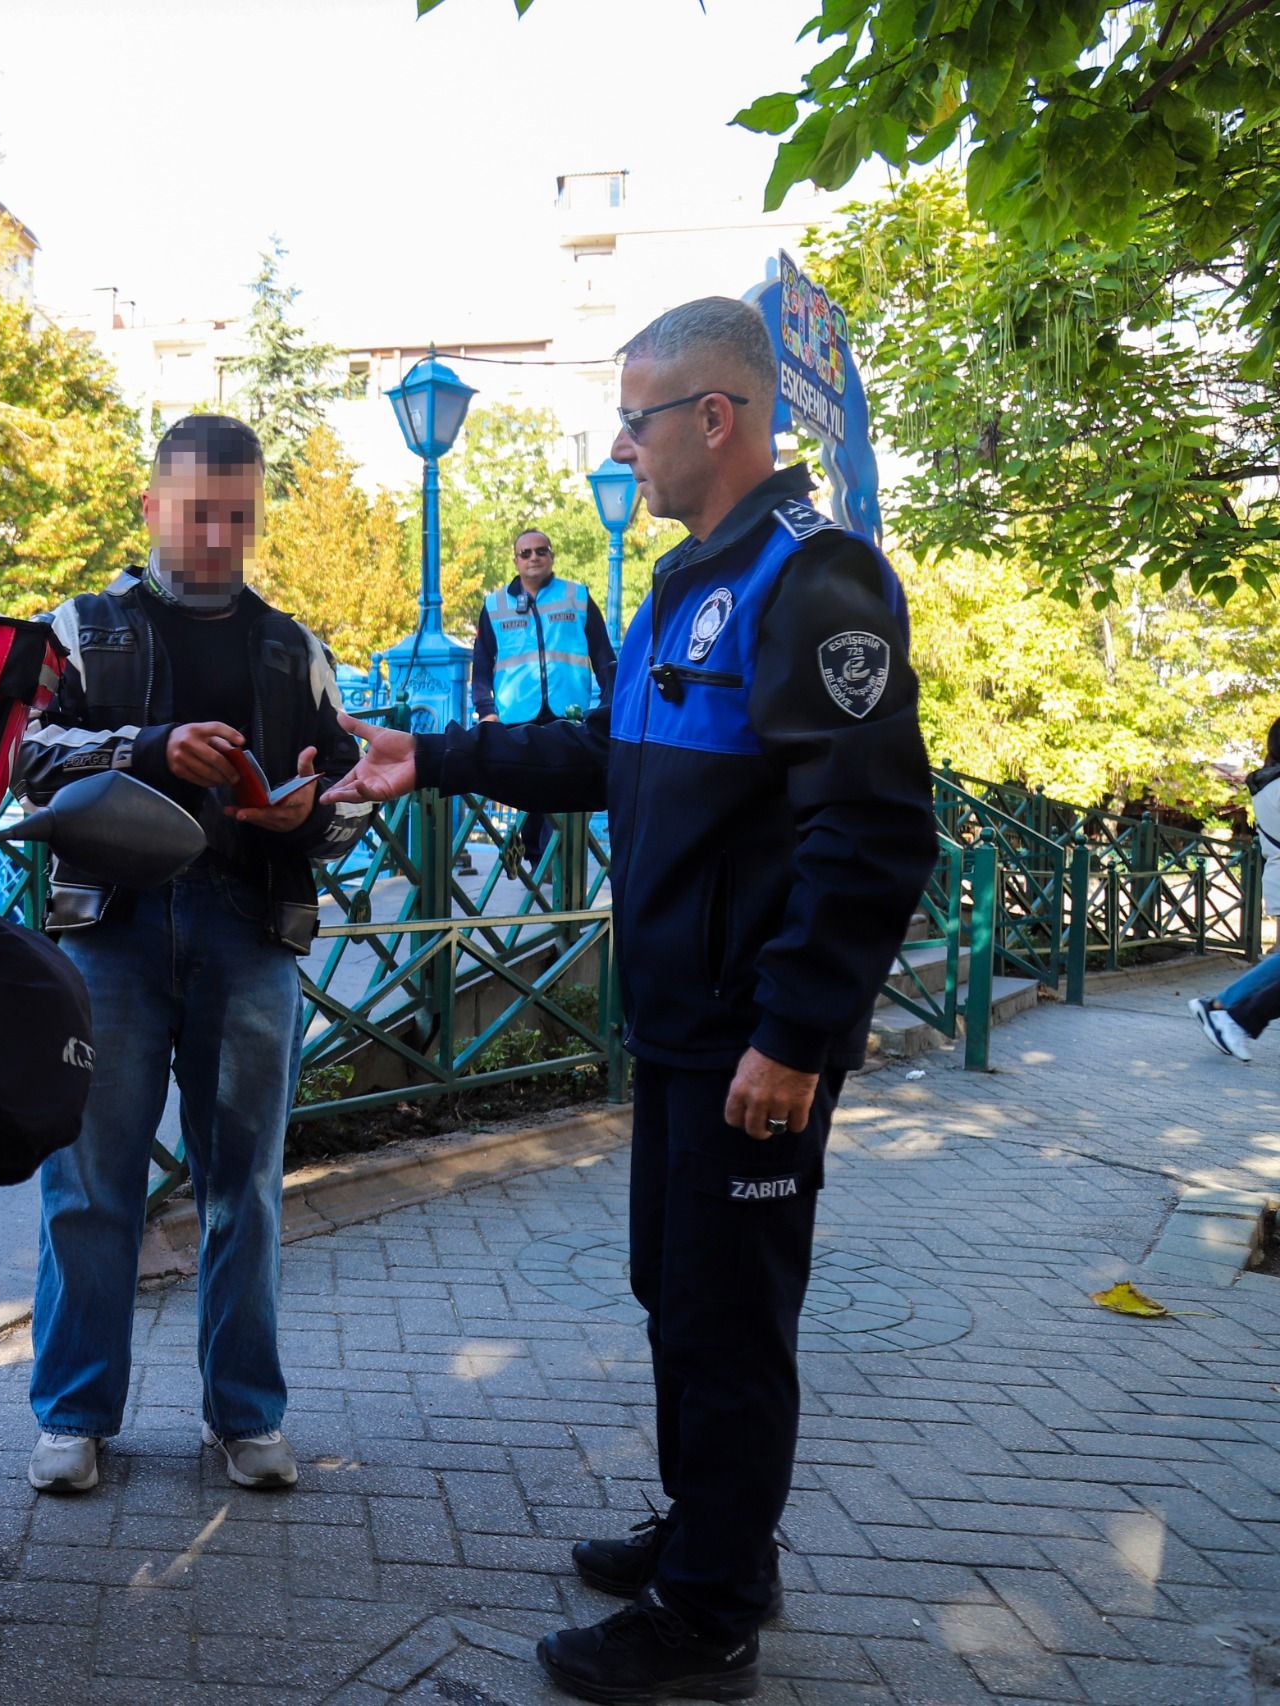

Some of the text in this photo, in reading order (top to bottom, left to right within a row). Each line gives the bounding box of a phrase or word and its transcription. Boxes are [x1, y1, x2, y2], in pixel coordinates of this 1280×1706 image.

[781, 360, 845, 441] ESKİŞEHİR YILI
[828, 633, 880, 652] ESKİŞEHİR
[730, 1178, 797, 1200] ZABITA
